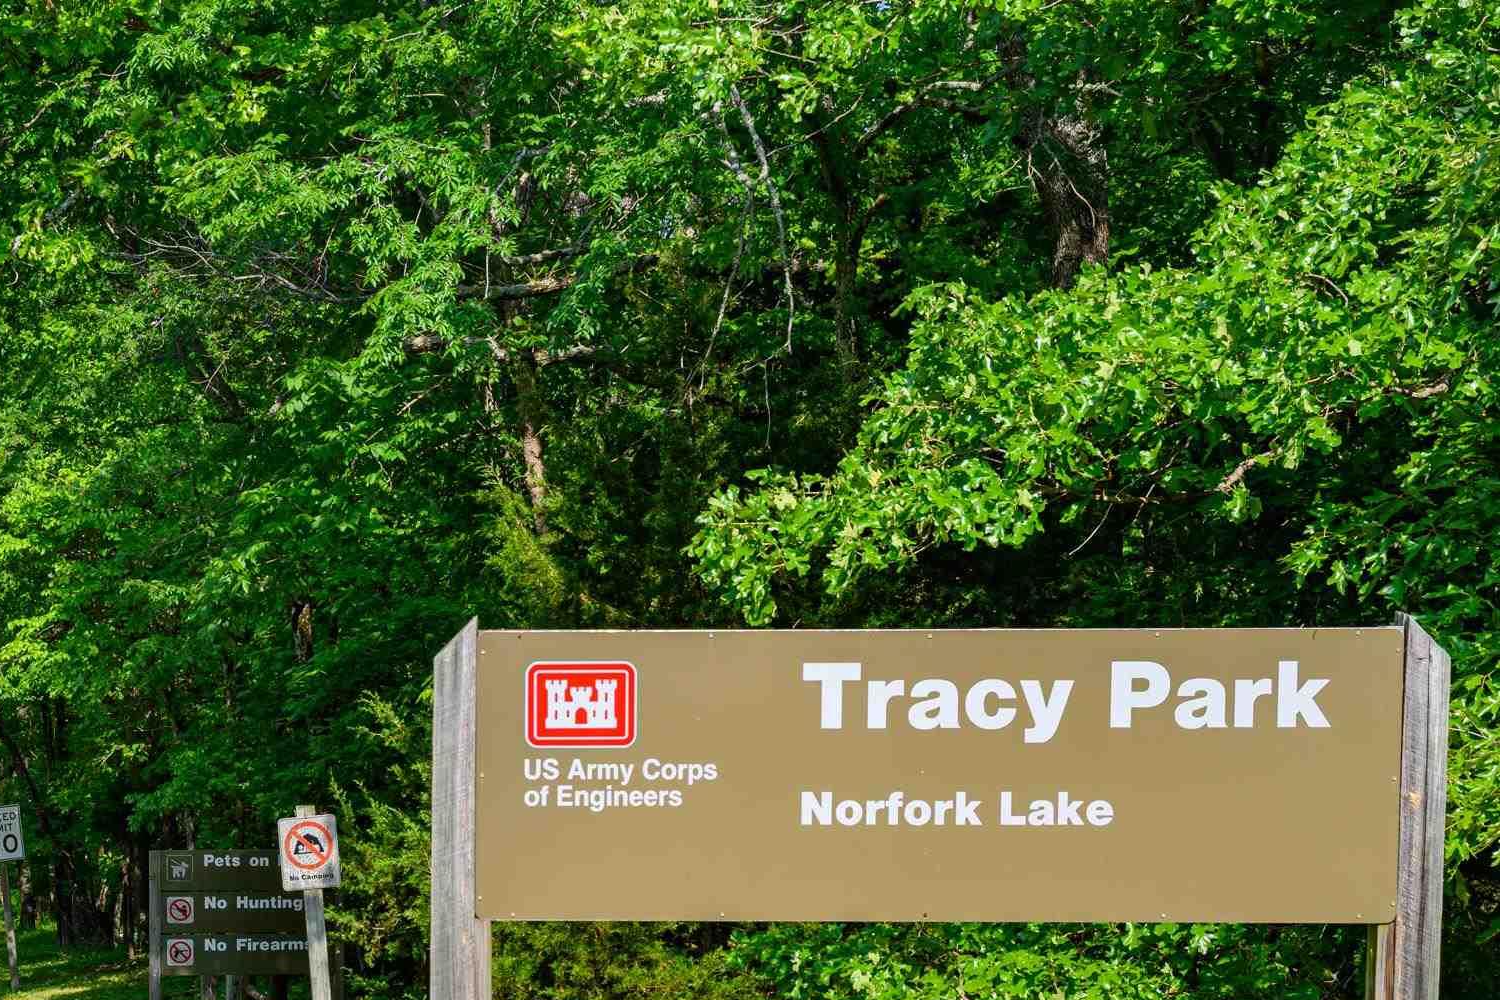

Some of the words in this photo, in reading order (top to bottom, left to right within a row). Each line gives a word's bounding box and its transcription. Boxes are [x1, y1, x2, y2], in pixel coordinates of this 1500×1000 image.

[802, 660, 1075, 744] Tracy
[1109, 660, 1332, 730] Park
[523, 758, 559, 780] US
[567, 757, 634, 786] Army
[641, 757, 718, 786] Corps
[523, 785, 549, 808] of
[556, 785, 682, 812] Engineers
[801, 791, 982, 827] Norfork
[999, 791, 1115, 827] Lake
[203, 854, 241, 867] Pets
[249, 857, 269, 867] on
[204, 896, 228, 909] No
[236, 896, 304, 912] Hunting
[204, 938, 228, 951] No
